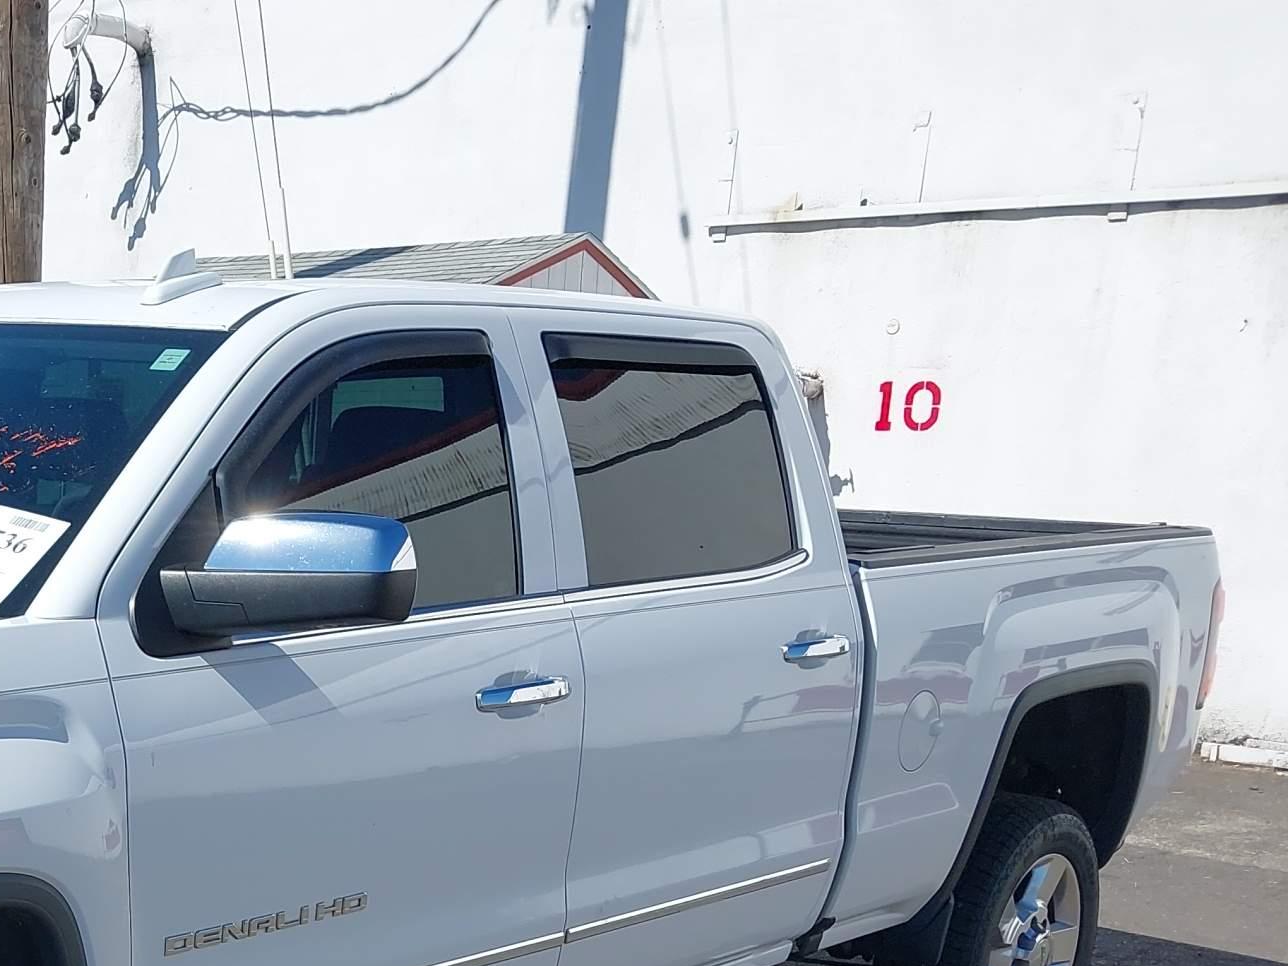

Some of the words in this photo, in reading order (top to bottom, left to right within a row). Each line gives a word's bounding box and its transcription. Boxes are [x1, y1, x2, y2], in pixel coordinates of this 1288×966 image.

[874, 380, 942, 432] 10
[163, 904, 309, 958] DENALI
[314, 891, 369, 921] HD
